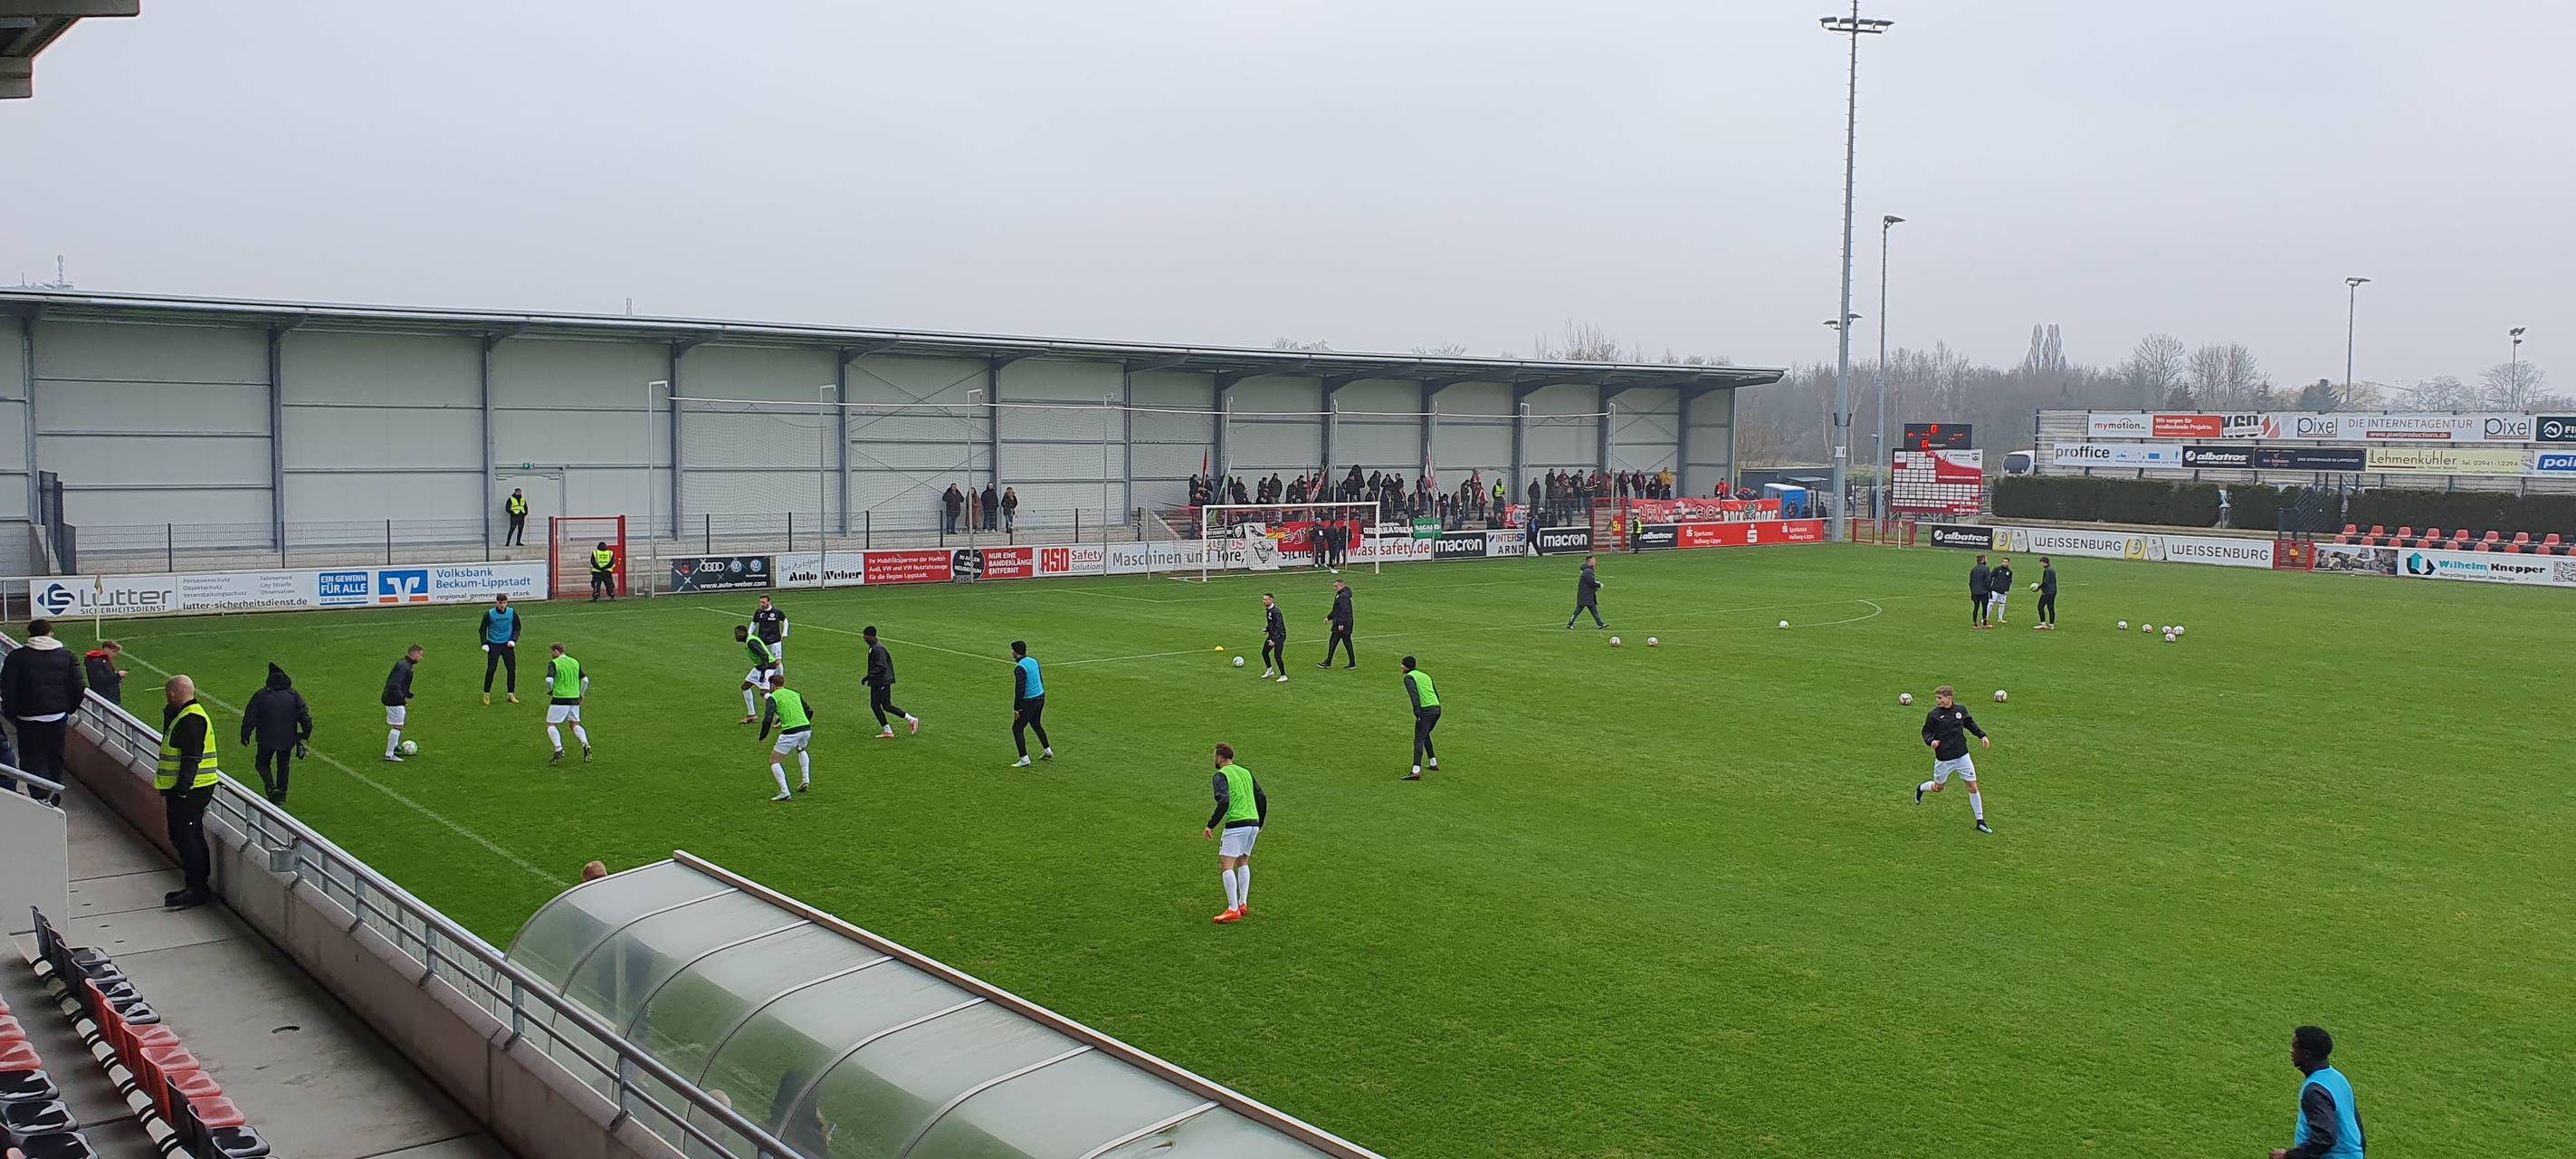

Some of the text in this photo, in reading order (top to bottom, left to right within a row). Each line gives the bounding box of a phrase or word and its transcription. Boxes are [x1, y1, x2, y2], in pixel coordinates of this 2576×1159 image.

[2348, 418, 2473, 429] DIE INTERNETAGENTUR
[2056, 445, 2111, 459] proffice
[2197, 452, 2247, 461] albatros
[2371, 450, 2457, 465] Lehmenkühler
[1543, 533, 1588, 547] macron
[1944, 532, 1989, 541] albatros
[1435, 538, 1483, 552] macron
[2035, 537, 2122, 551] WEISSENBURG
[1072, 550, 1103, 561] Safety
[2172, 543, 2269, 560] WEISSENBURG
[988, 558, 1033, 567] BANDENLÄNGE
[1041, 548, 1069, 572] ASO
[1112, 549, 1181, 567] Maschinen
[436, 568, 493, 578] Volksbank
[988, 567, 1019, 575] ENTFERNT
[1072, 563, 1103, 571] Solutions
[2438, 560, 2546, 574] Wilhelm Knepper
[320, 574, 367, 583] EIN GEWINN
[789, 570, 862, 581] Auto Weber
[320, 582, 367, 594] FÜR ALLE
[436, 577, 531, 589] Beckum-Lippstadt
[700, 580, 767, 589] www.auto-weber.com
[80, 589, 173, 608] Lutter
[183, 598, 308, 610] lutter-sicherheitsdienst.de
